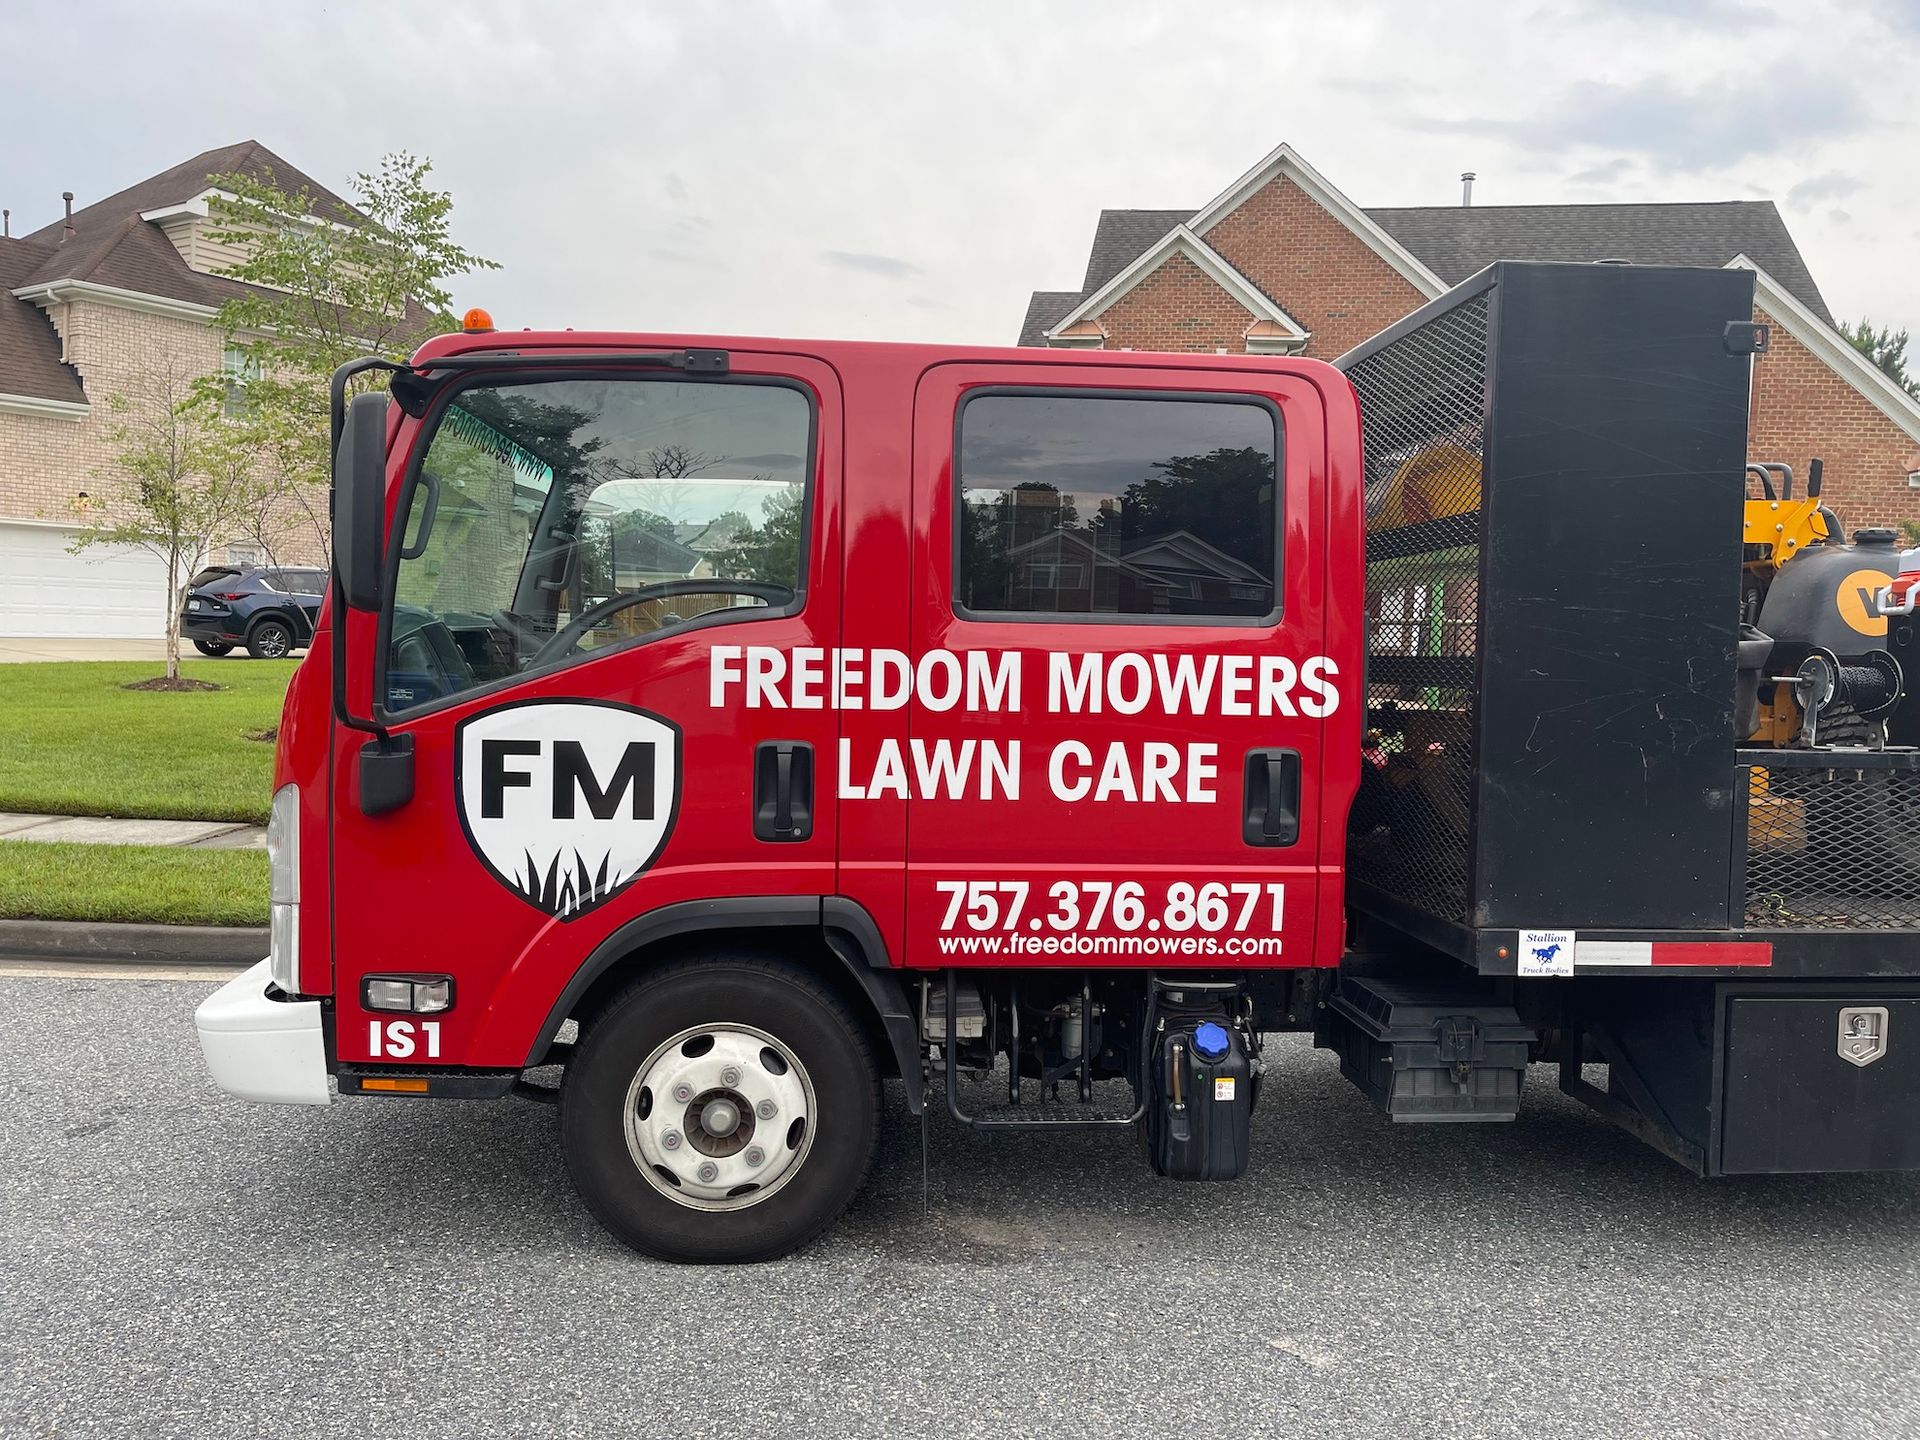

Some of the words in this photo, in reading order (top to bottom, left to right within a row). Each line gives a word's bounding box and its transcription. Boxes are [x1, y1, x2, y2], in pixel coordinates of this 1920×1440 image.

[709, 645, 1022, 712] FREEDOM
[1048, 651, 1340, 718] MOWERS
[482, 740, 655, 820] FM
[837, 737, 1021, 802] LAWN
[1048, 740, 1218, 803] CARE
[936, 881, 1285, 932] 757.376.8671
[938, 932, 1283, 956] www.freedommowers.com
[1526, 933, 1567, 942] Stallion
[369, 1020, 440, 1058] IS1
